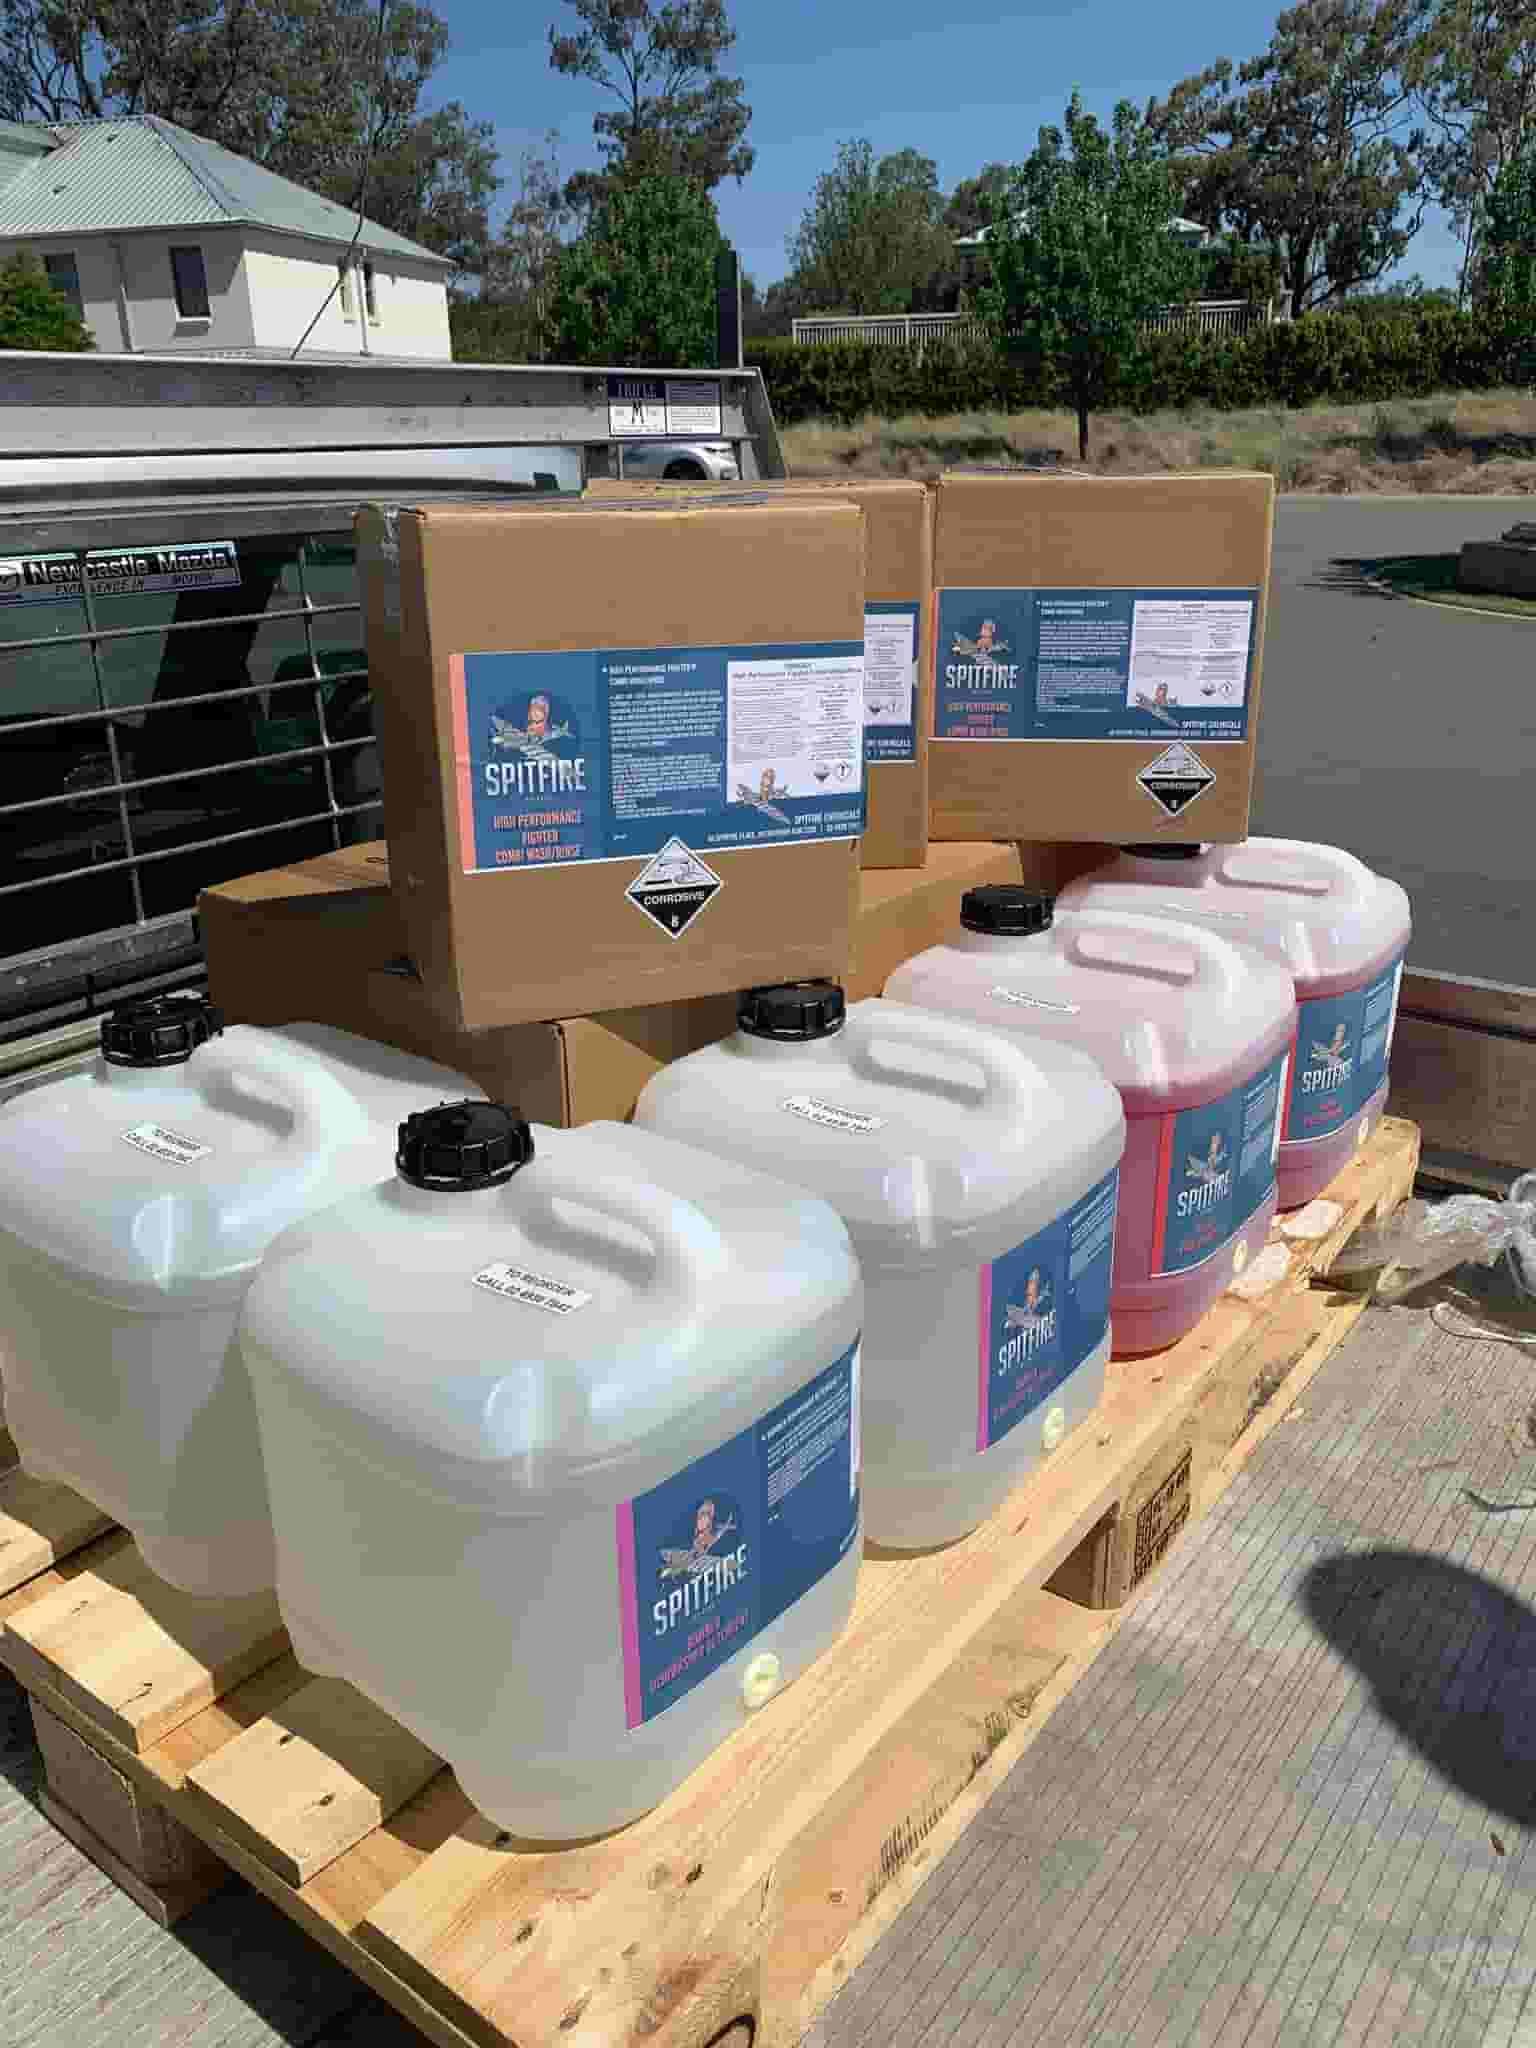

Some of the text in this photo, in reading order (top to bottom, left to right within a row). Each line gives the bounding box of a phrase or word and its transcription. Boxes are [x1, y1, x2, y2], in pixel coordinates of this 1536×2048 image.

[29, 549, 229, 584] Newcastle Mazda
[944, 664, 1018, 689] SPITFIRE
[484, 757, 588, 799] SPITFIRE
[518, 807, 584, 829] PERFORMANCE
[643, 890, 705, 907] CORROSIVE
[1176, 1169, 1233, 1218] SPITFIRE
[476, 1274, 505, 1291] CALL
[521, 1273, 577, 1297] REORDER
[998, 1308, 1057, 1378] SPITFIRE
[653, 1542, 752, 1637] SPITFIRE
